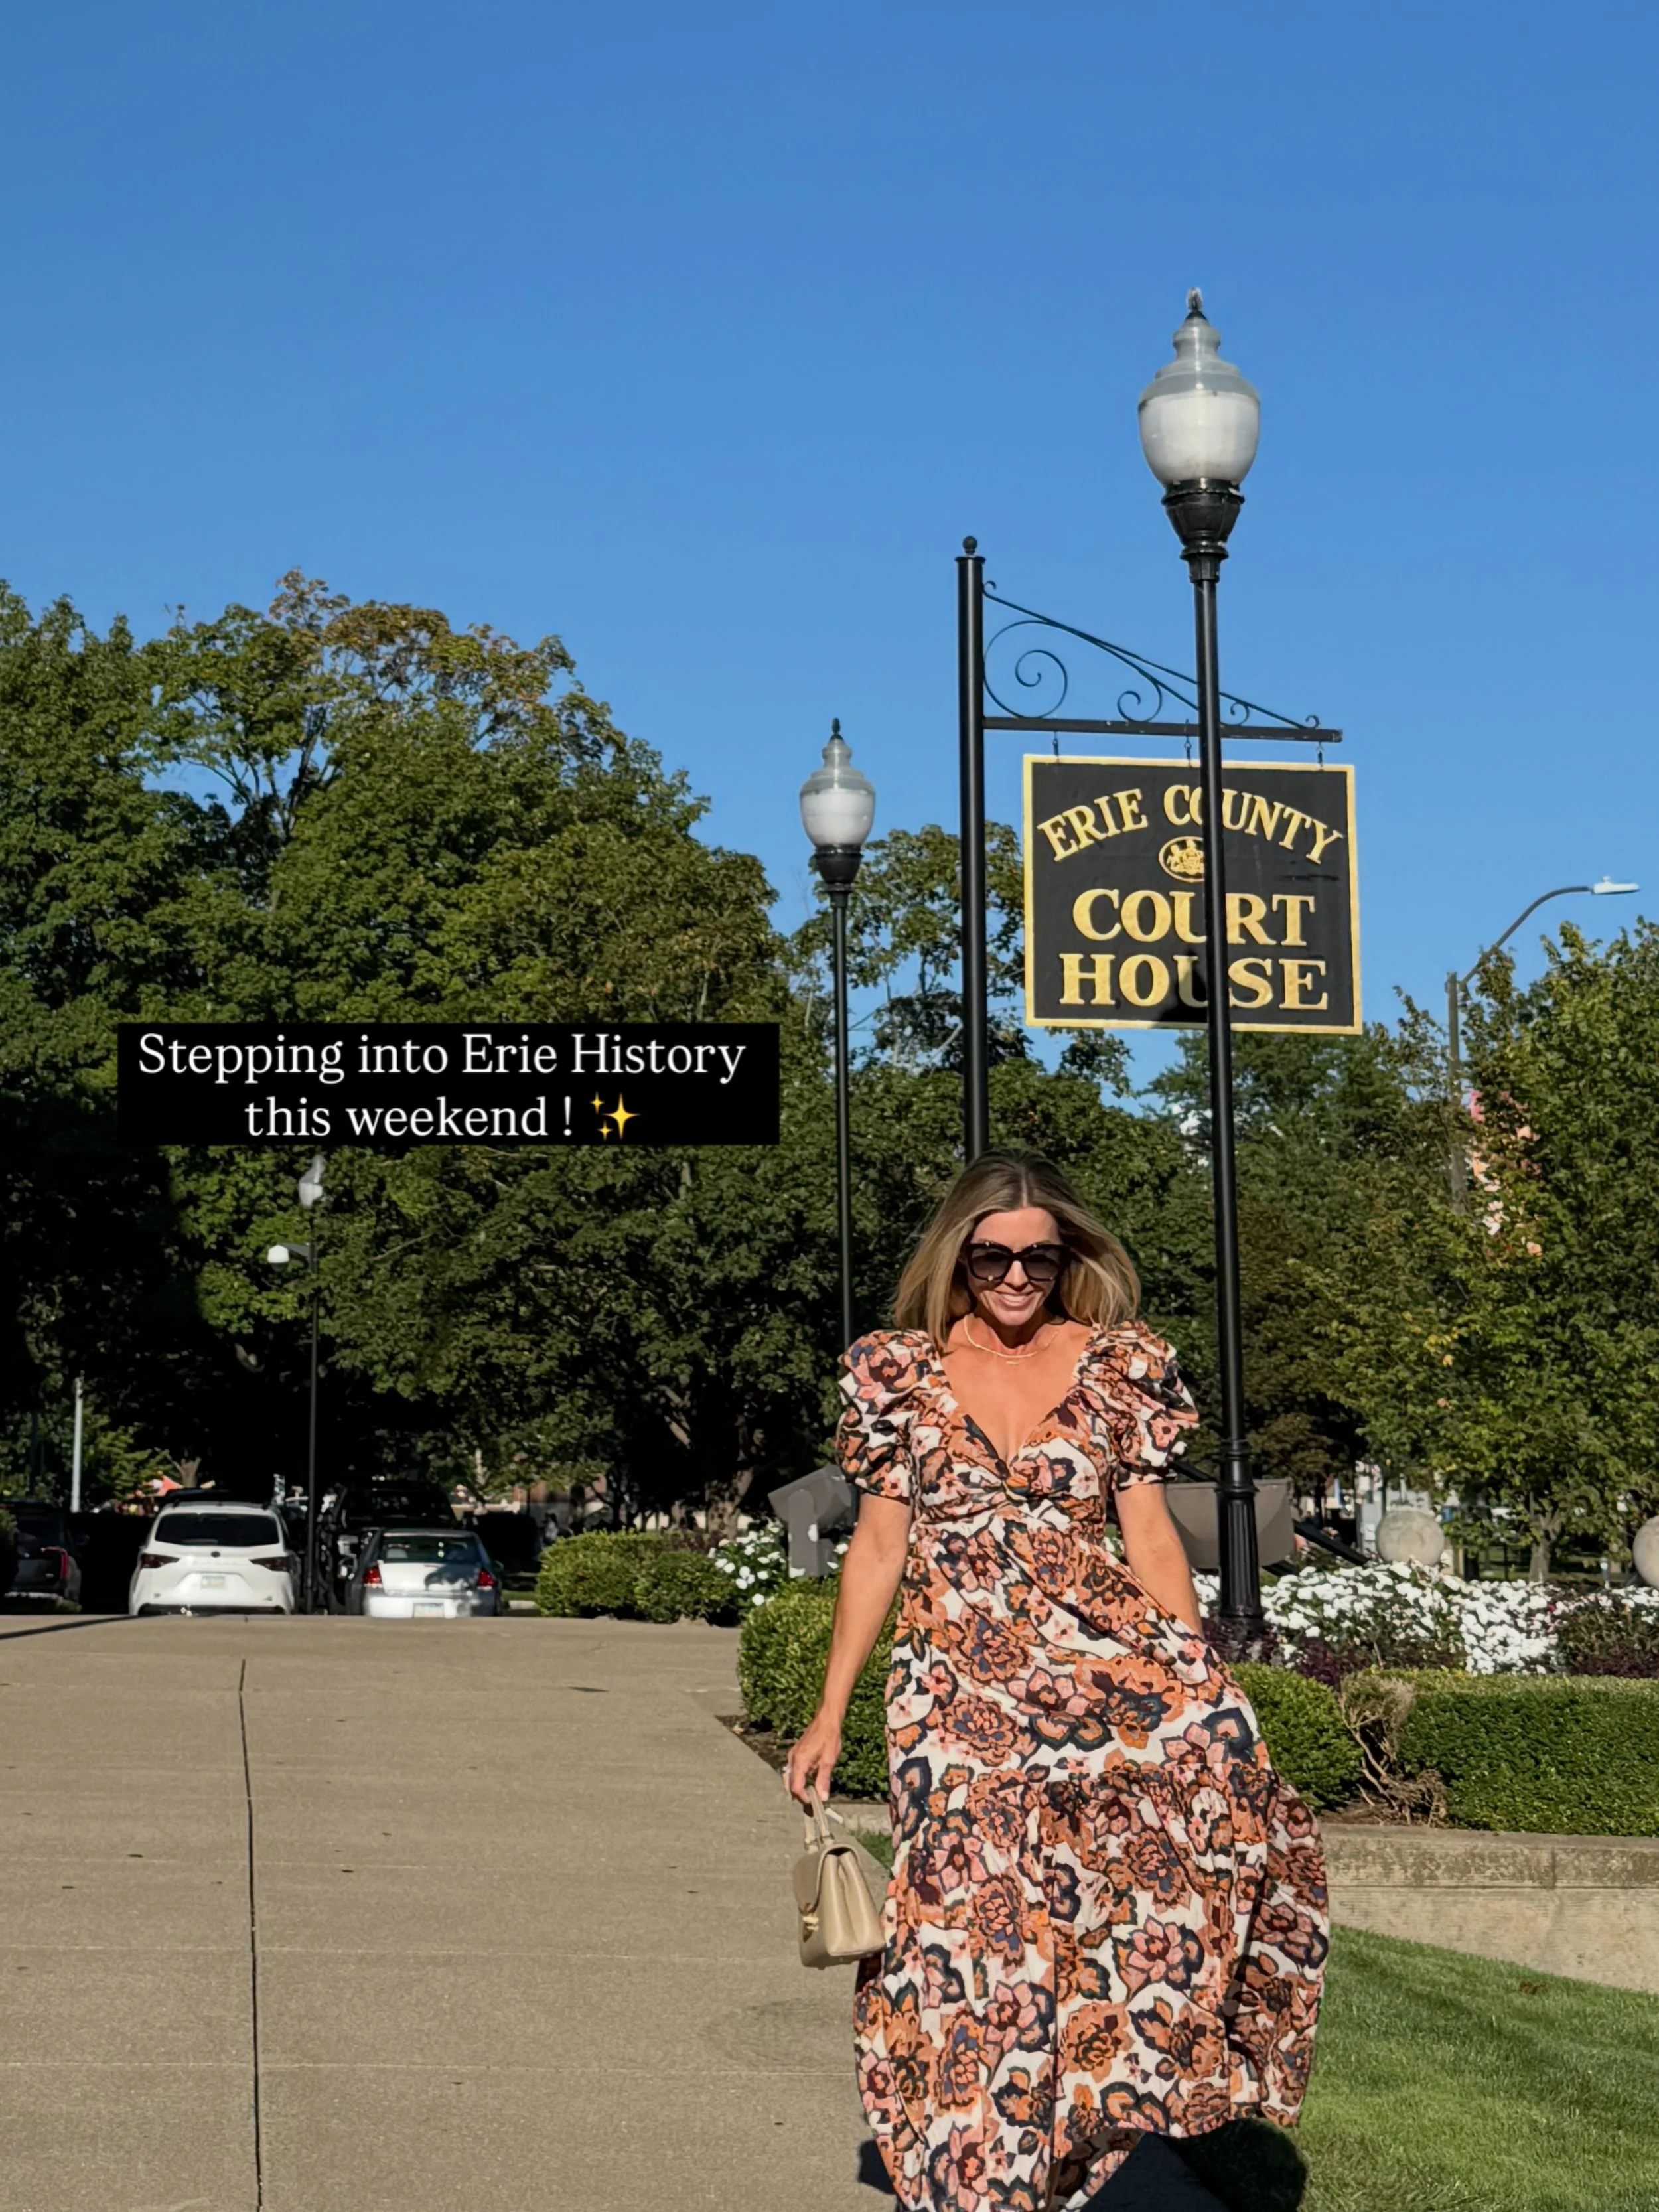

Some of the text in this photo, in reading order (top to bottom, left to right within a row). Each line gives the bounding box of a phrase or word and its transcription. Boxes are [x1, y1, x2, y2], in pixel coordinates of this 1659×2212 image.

[1037, 788, 1149, 862] ERIE
[1072, 888, 1316, 946] COURT
[1059, 953, 1328, 1010] HOUSE
